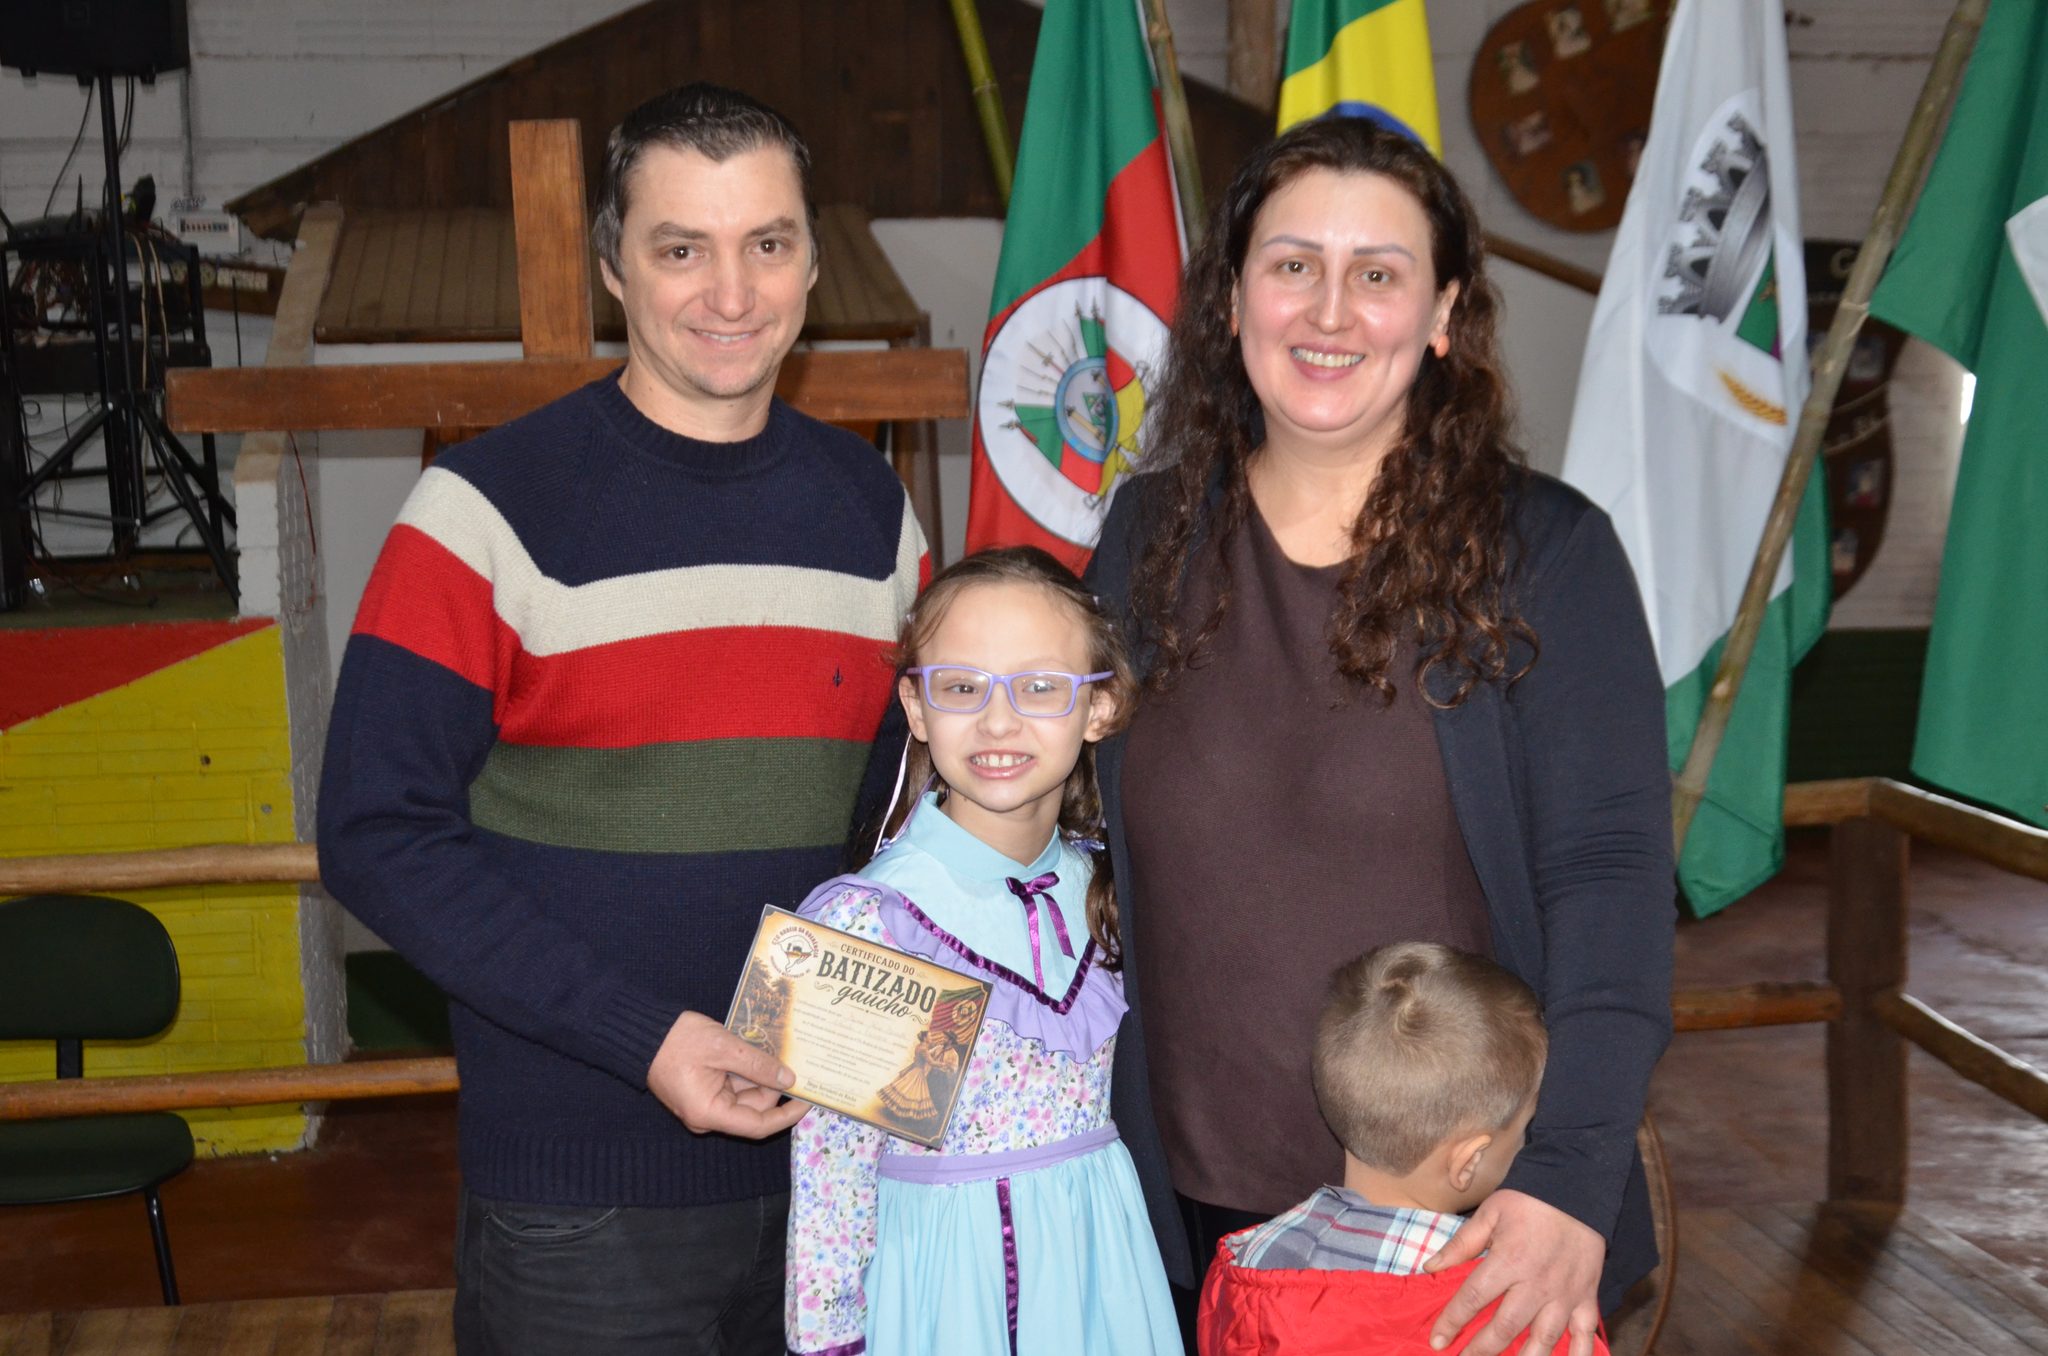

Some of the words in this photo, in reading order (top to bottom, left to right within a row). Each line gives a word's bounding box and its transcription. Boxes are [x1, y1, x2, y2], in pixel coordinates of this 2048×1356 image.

[840, 943, 900, 971] CERTIFICADO
[902, 966, 915, 976] DO
[816, 950, 937, 1013] BATIZADO
[831, 985, 911, 1018] gaúcho
